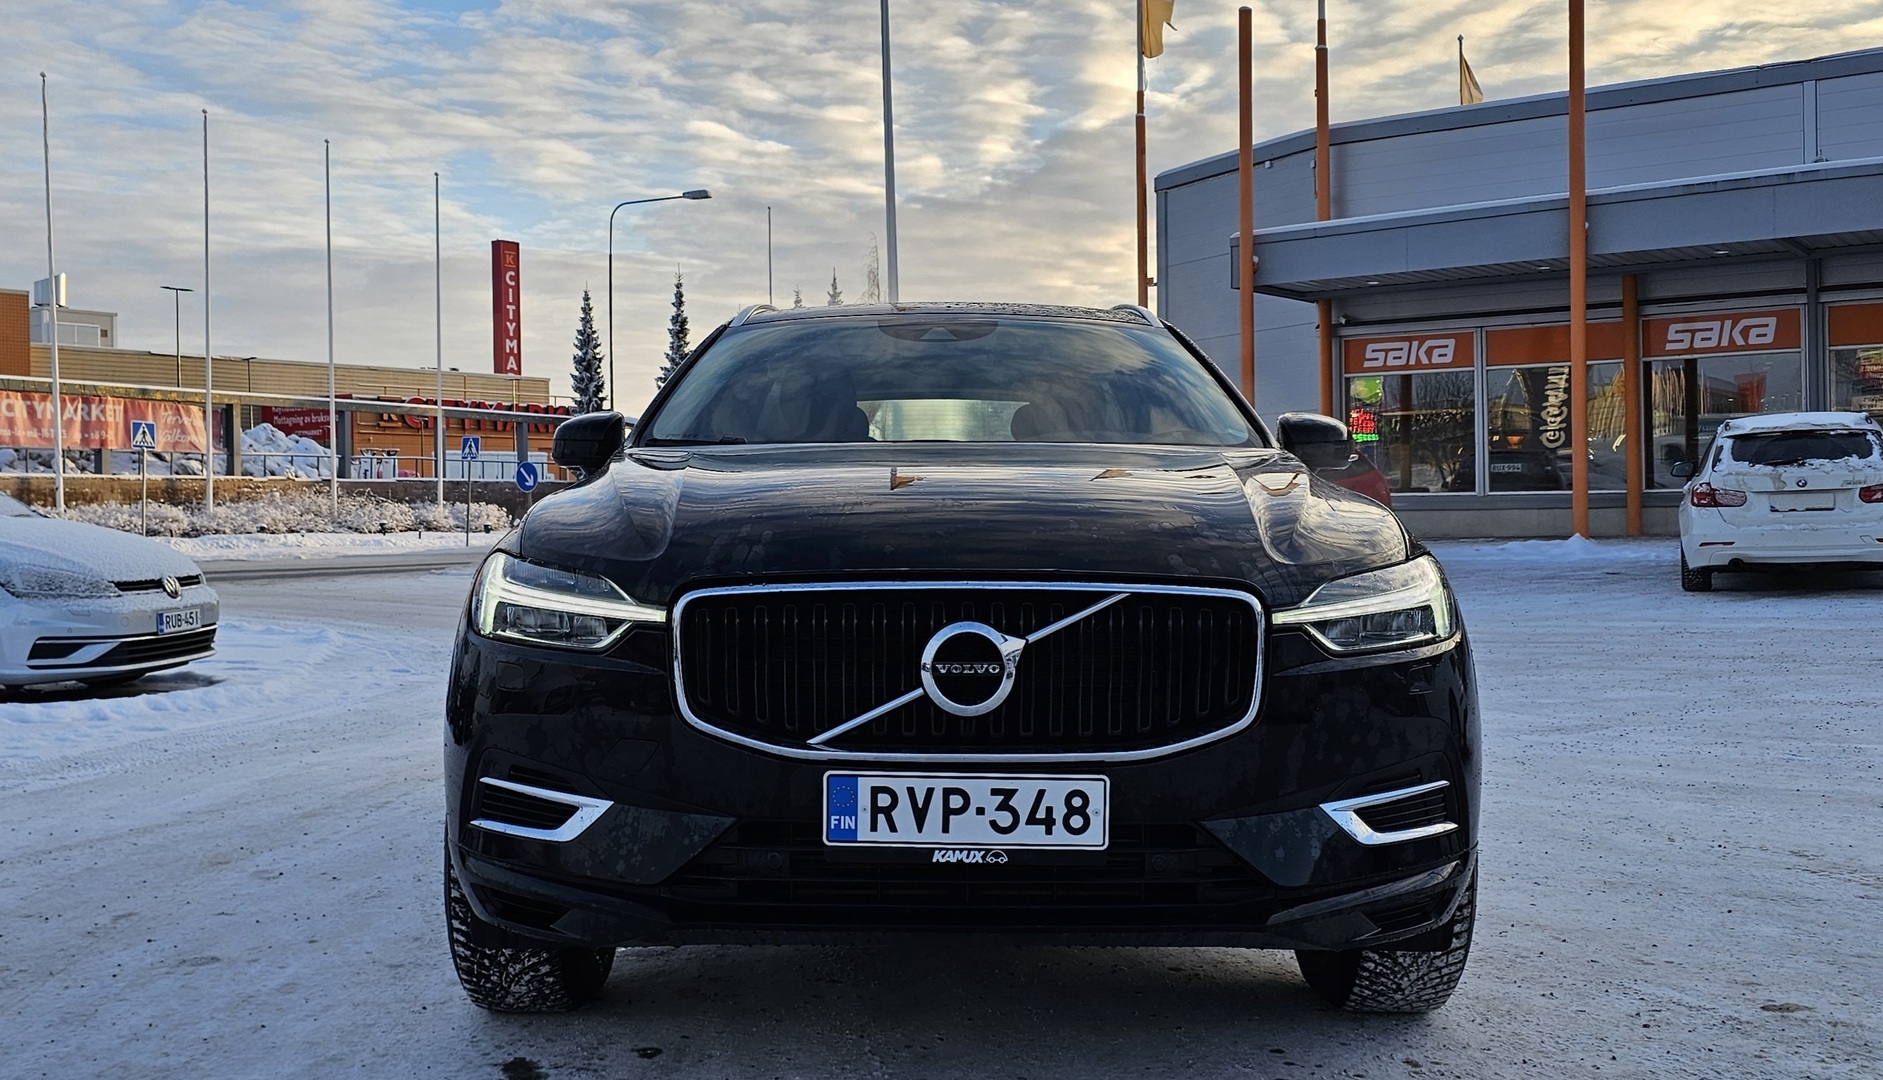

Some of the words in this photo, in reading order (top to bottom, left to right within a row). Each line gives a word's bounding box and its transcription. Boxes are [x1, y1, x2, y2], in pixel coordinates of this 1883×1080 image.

[505, 271, 518, 375] CITYMA
[165, 610, 199, 630] RUB-451
[935, 663, 1001, 674] VOLVO
[869, 785, 1091, 836] RVP-348
[830, 816, 855, 829] FIN
[932, 850, 986, 863] KAMUX
